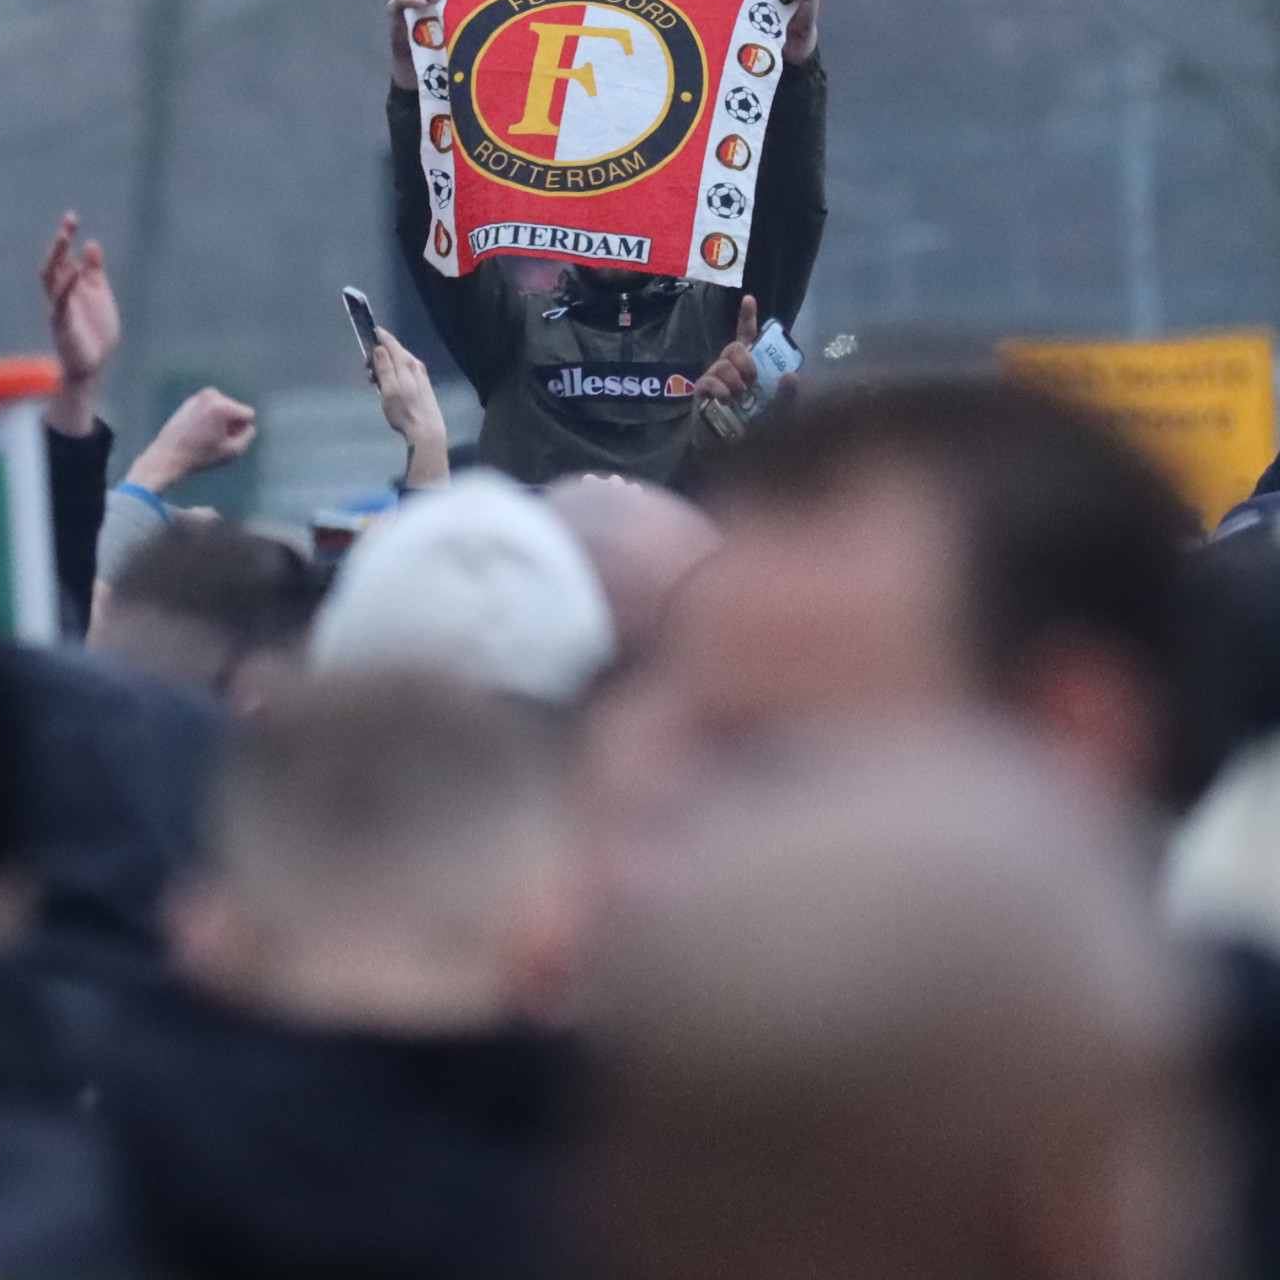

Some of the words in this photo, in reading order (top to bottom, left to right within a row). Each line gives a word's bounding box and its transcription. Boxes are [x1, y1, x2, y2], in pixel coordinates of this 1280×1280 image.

[507, 21, 634, 136] F
[473, 139, 647, 188] ROTTERDAM
[548, 367, 661, 398] ellesse
